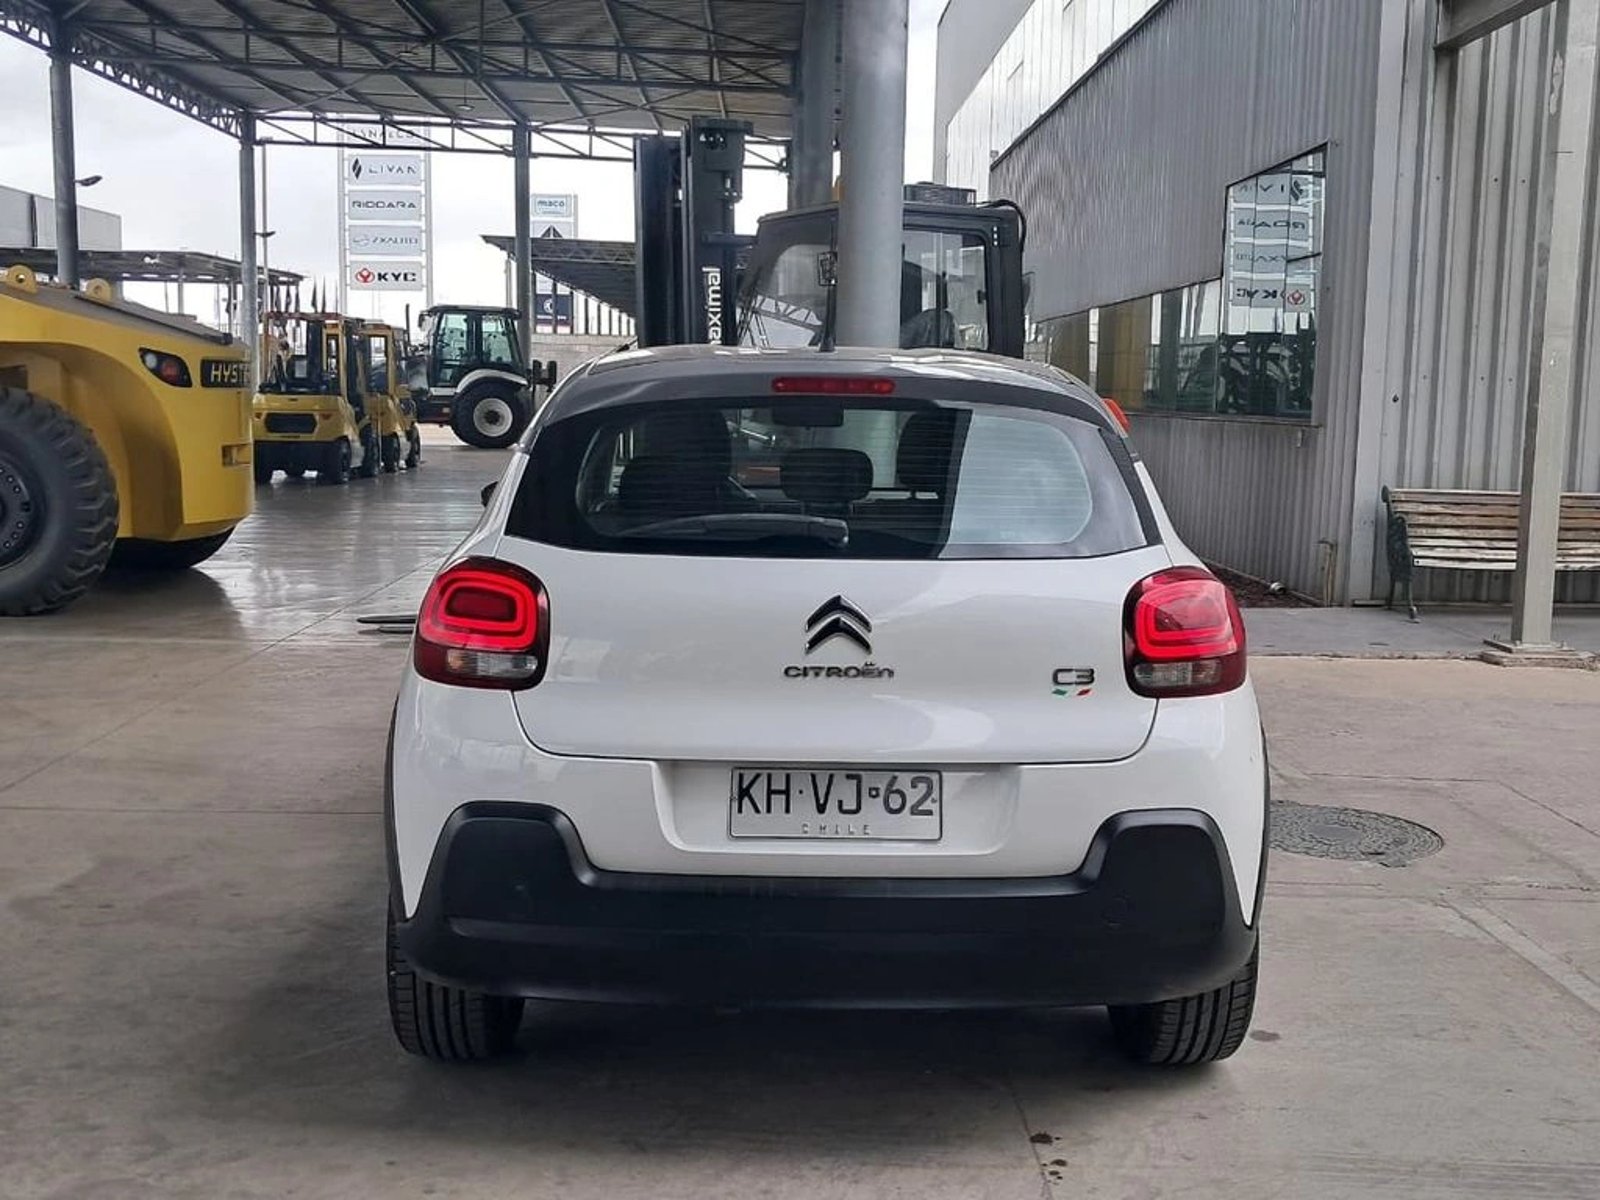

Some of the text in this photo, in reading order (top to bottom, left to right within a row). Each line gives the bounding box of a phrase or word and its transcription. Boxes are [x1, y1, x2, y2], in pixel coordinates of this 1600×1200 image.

[368, 165, 416, 174] LIVAN
[352, 200, 417, 209] RIDDARA
[377, 271, 417, 282] KYC
[702, 266, 722, 345] aximal
[1052, 668, 1095, 685] C3
[800, 823, 871, 836] CHILE
